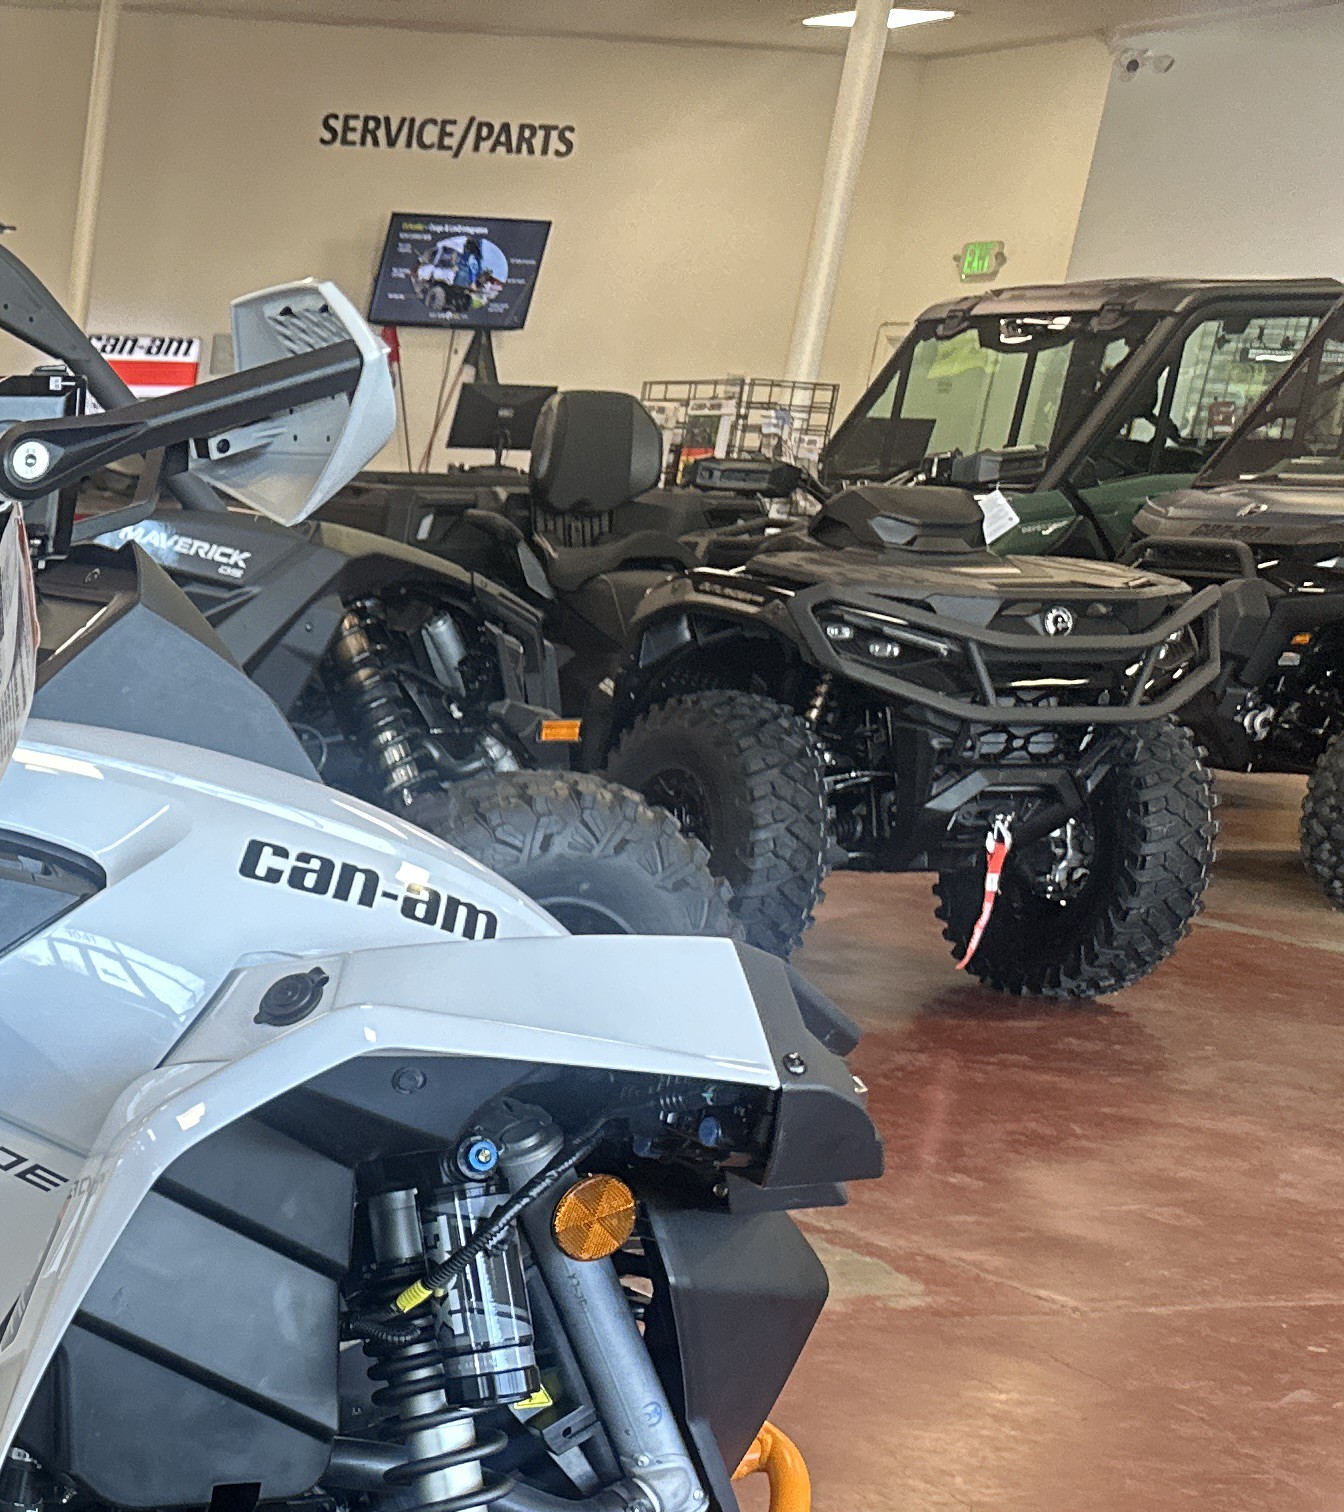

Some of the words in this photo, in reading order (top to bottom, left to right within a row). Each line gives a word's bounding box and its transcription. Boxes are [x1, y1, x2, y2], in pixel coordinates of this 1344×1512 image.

[319, 111, 575, 158] SERVICE/PARTS
[118, 525, 252, 569] MAVERICK
[238, 836, 500, 942] can-am
